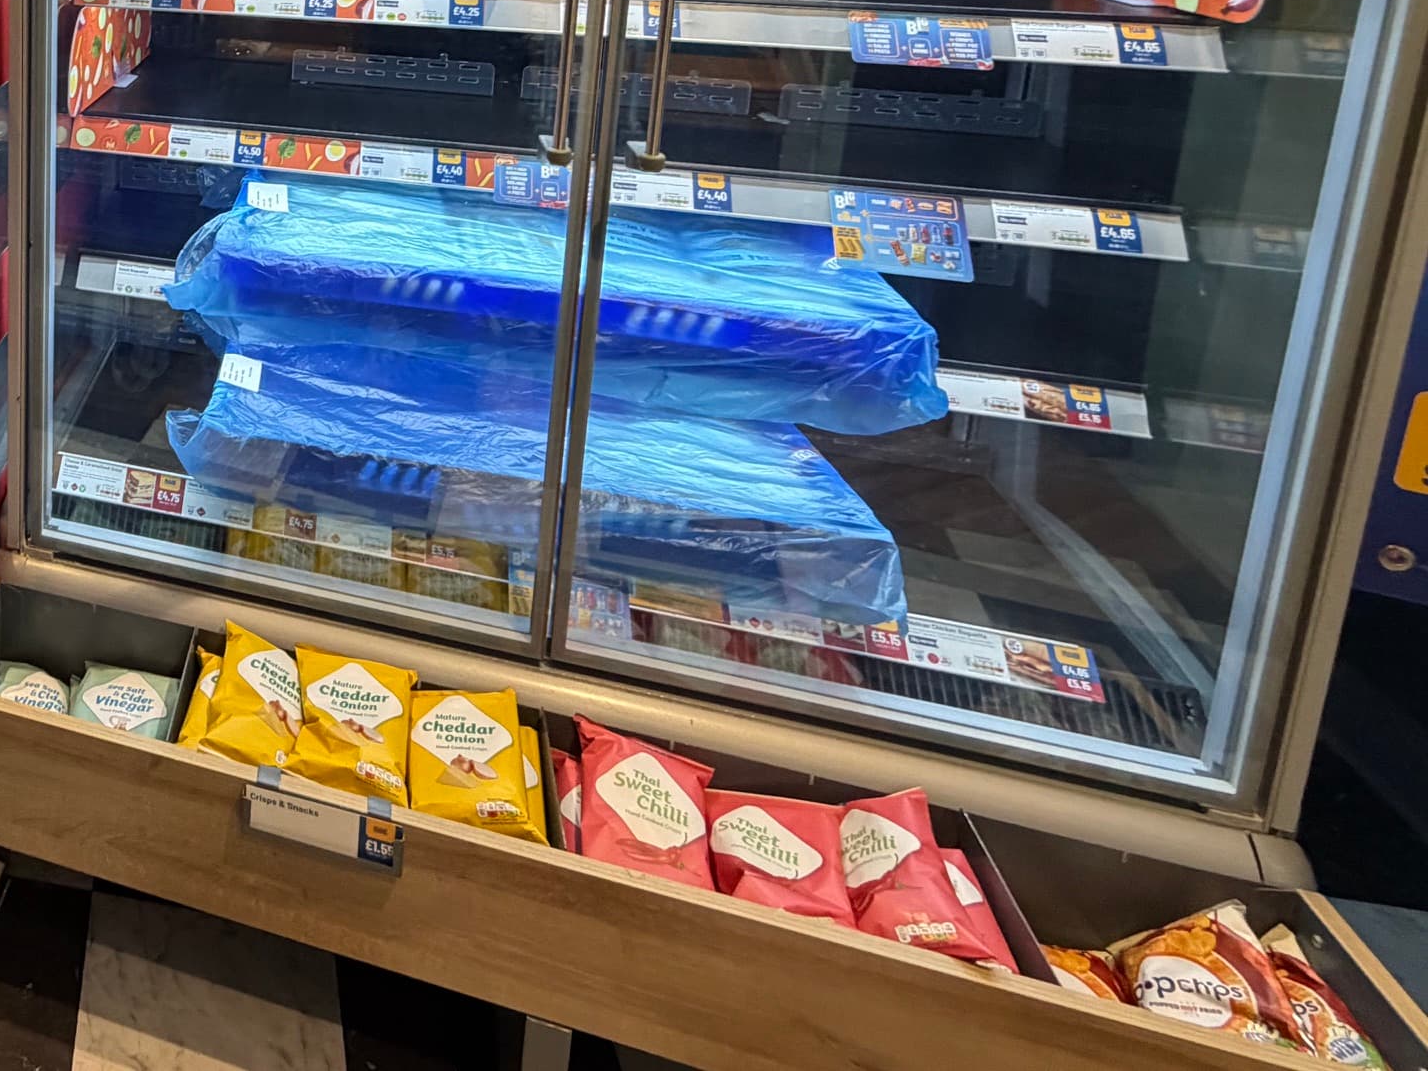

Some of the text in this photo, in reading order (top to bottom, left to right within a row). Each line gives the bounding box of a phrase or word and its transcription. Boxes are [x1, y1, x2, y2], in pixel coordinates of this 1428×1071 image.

[308, 0, 334, 8] £4.25
[453, 6, 480, 17] £4.25
[238, 145, 262, 157] £4.50
[436, 164, 462, 176] £4.40
[697, 190, 727, 201] £4.40
[1100, 227, 1136, 240] £4.65
[157, 490, 181, 503] £4.75
[289, 517, 314, 529] £4.75
[871, 631, 902, 647] £5.15
[264, 657, 290, 676] Mature
[126, 684, 146, 694] Salt
[333, 680, 363, 690] Mature
[121, 692, 154, 705] Cider
[319, 684, 390, 703] Cheddar
[339, 700, 378, 711] Onion
[435, 713, 466, 721] Mature
[422, 721, 496, 735] Cheddar
[444, 734, 485, 744] Onion
[633, 769, 661, 788] Thai
[614, 771, 672, 804] Sweet
[250, 791, 320, 818] Crisps & Snacks
[636, 795, 689, 827] Chilli
[737, 817, 768, 833] Thai
[718, 820, 780, 847] Sweet
[843, 826, 867, 845] Thai
[365, 839, 394, 857] £1.55
[742, 835, 799, 866] Chilli
[848, 835, 897, 864] Chilli
